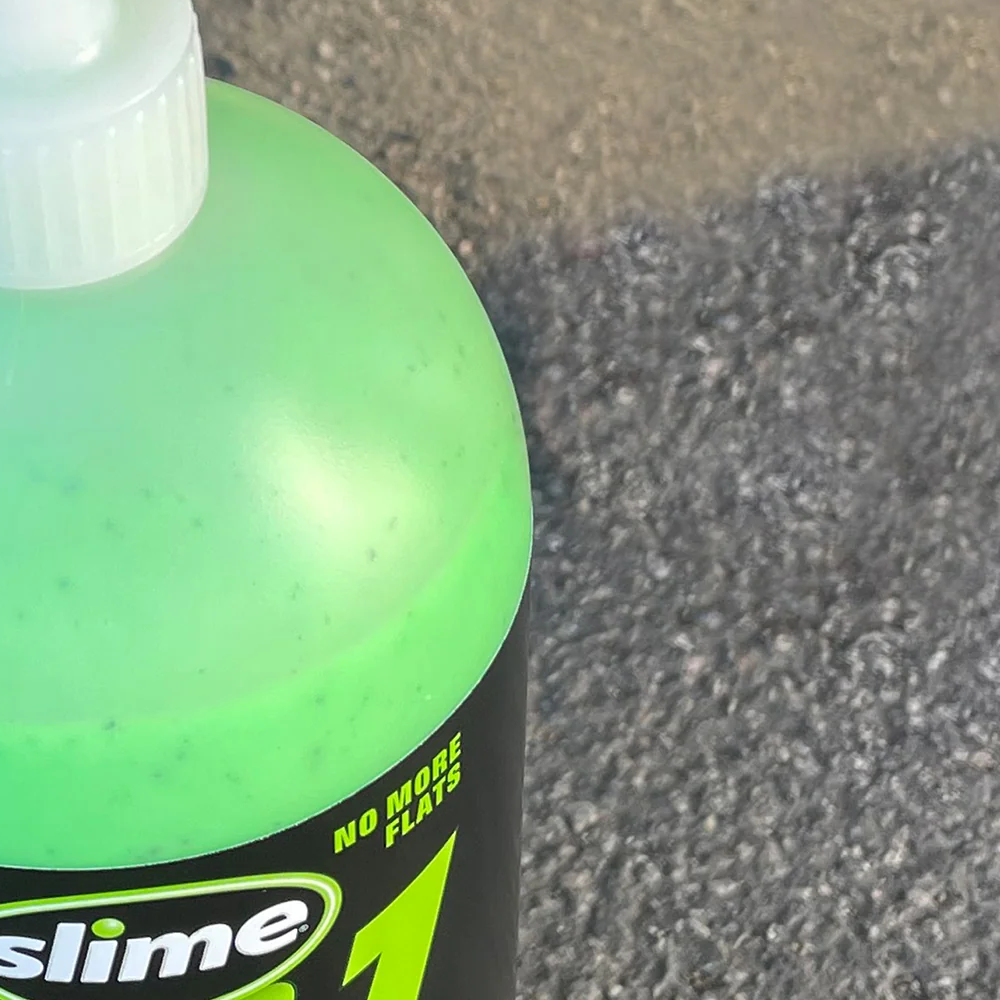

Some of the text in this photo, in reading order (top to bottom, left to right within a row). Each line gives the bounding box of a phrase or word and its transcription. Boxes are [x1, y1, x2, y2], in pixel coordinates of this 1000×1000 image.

[334, 731, 461, 854] NO MORE
[385, 761, 461, 849] FLATS
